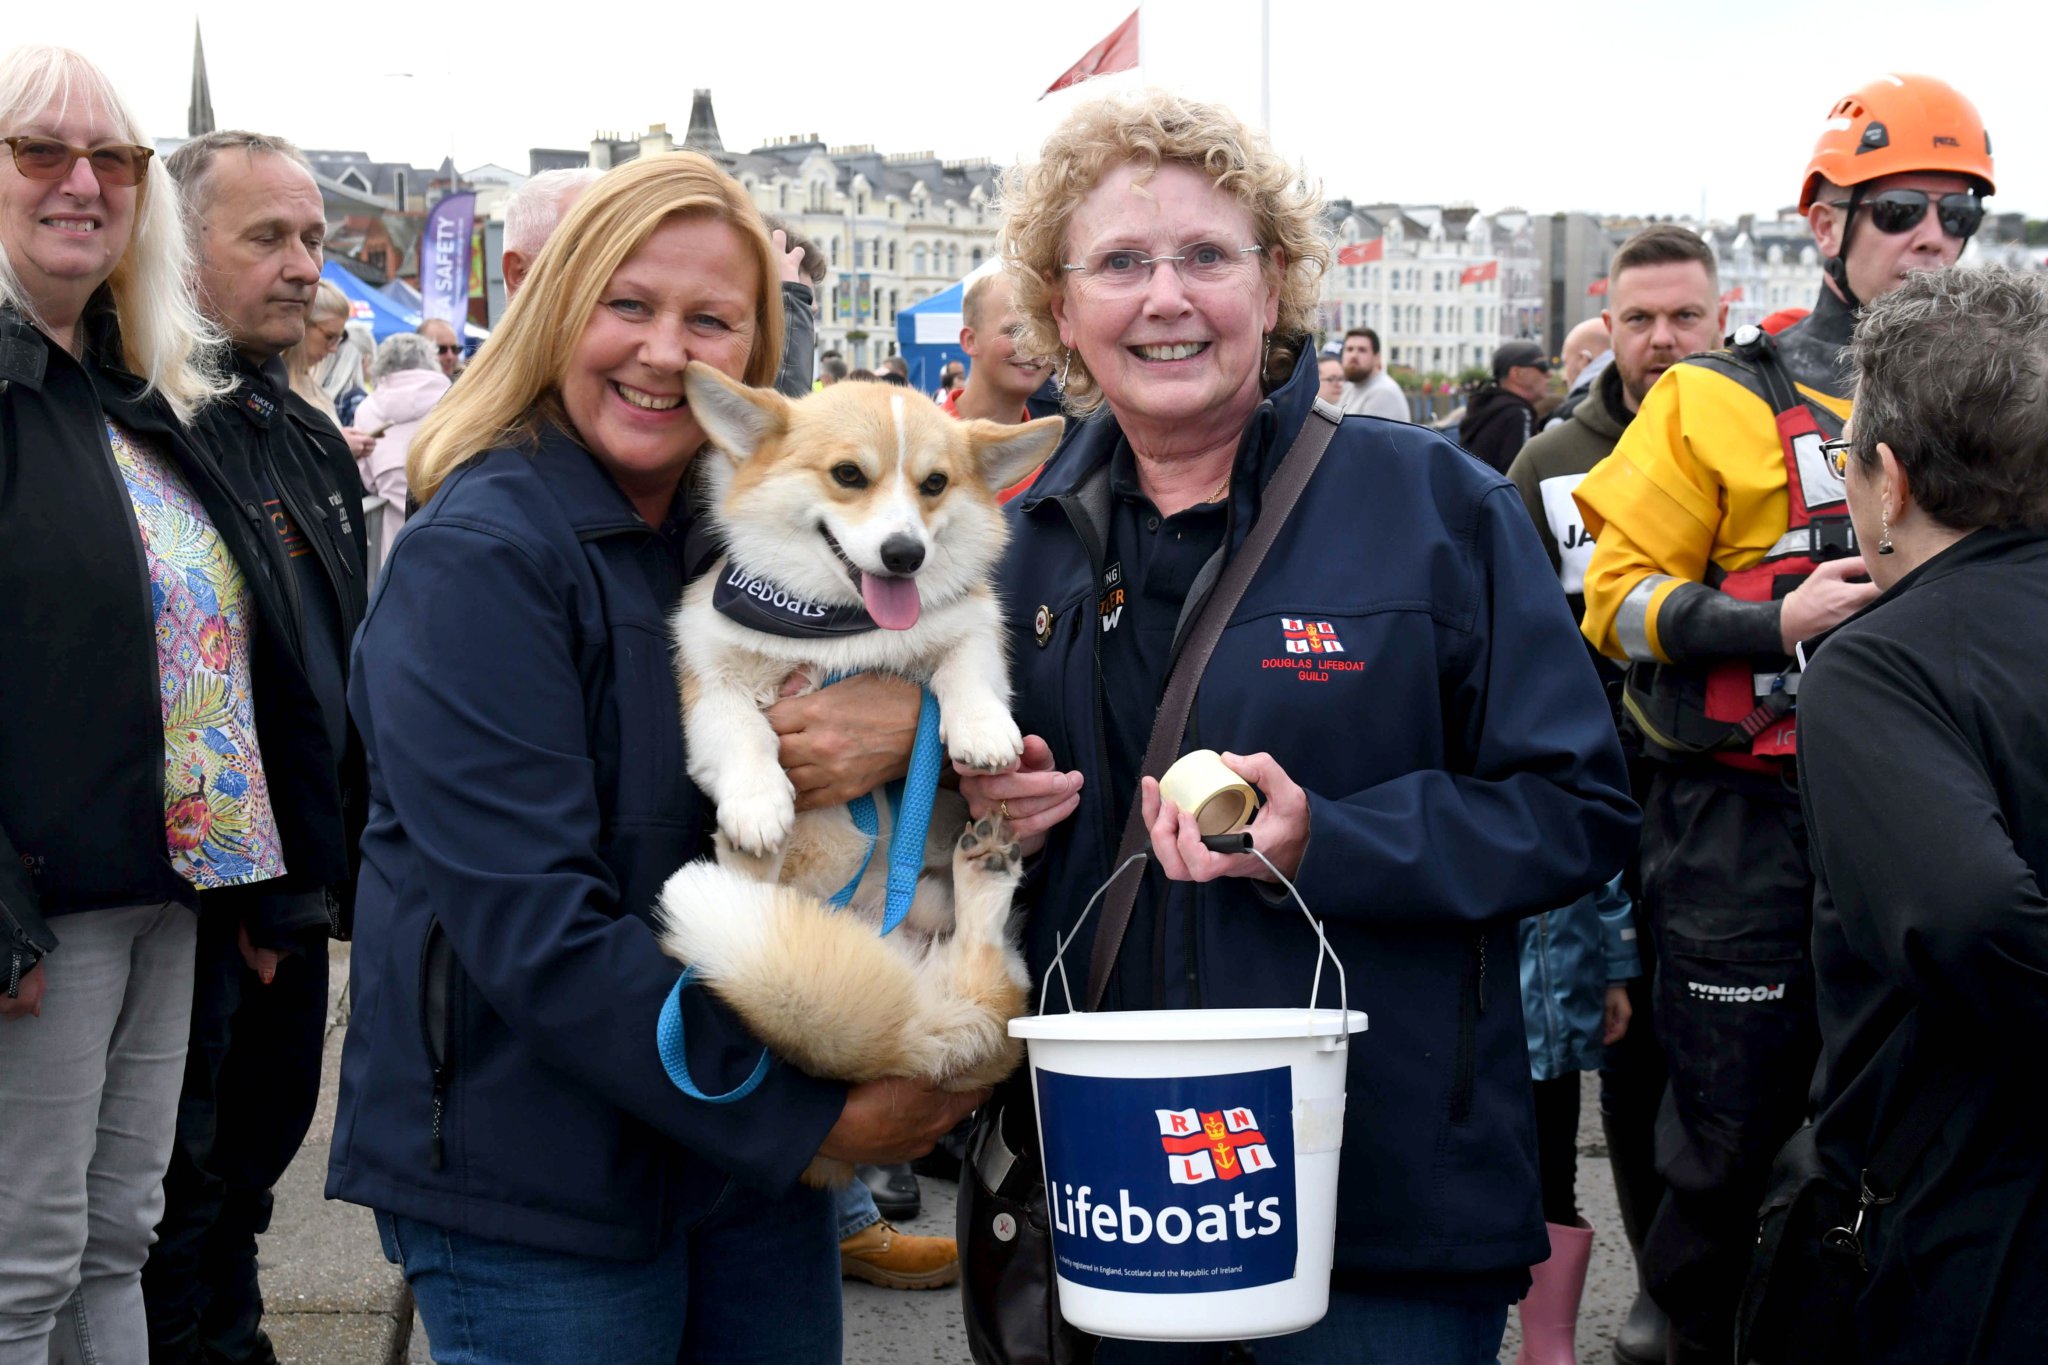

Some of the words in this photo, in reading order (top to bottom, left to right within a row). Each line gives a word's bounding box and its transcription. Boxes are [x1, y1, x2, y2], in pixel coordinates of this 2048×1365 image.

[435, 216, 455, 292] SAFETY
[250, 393, 274, 411] rukka
[1262, 659, 1312, 669] DOUGLAS
[1318, 660, 1365, 671] LIFEBOAT
[1298, 671, 1329, 682] GUILD
[1688, 981, 1785, 1002] TYPHOON
[1052, 1180, 1281, 1245] Lifeboats
[1072, 1261, 1093, 1270] registered
[1094, 1264, 1099, 1272] in
[1100, 1265, 1124, 1276] England,
[1124, 1268, 1152, 1277] Scotland
[1153, 1269, 1166, 1277] and
[1167, 1269, 1179, 1277] the
[1180, 1267, 1210, 1278] Republic
[1211, 1267, 1218, 1275] of
[1219, 1264, 1243, 1274] Ireland
